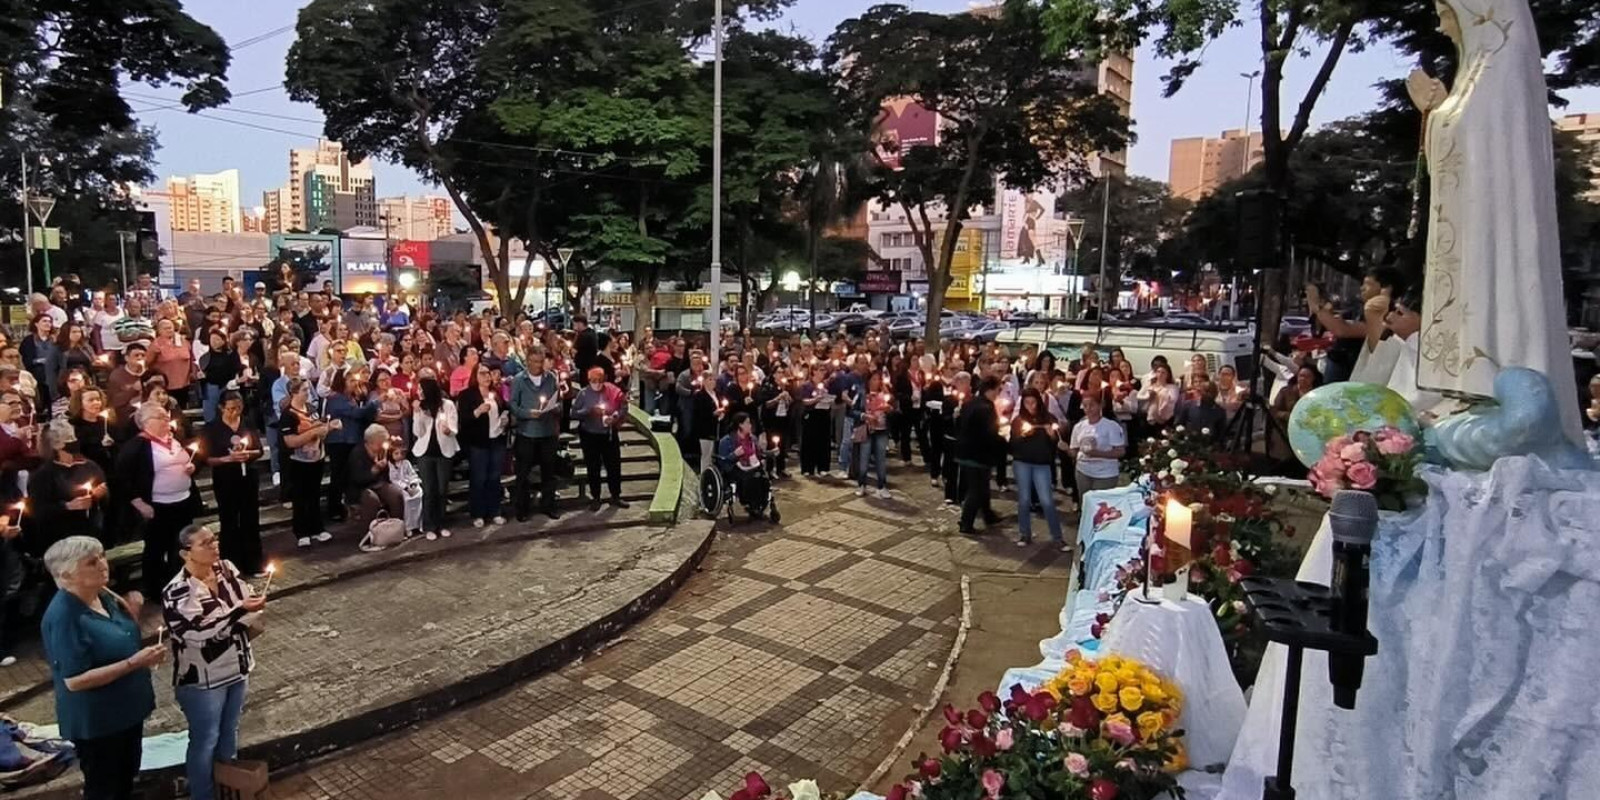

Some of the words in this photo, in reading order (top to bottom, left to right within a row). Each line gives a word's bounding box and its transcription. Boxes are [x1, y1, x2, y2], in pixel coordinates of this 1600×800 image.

[346, 262, 387, 271] PLANETA
[599, 293, 633, 304] PASTEL
[685, 294, 712, 306] PASTE
